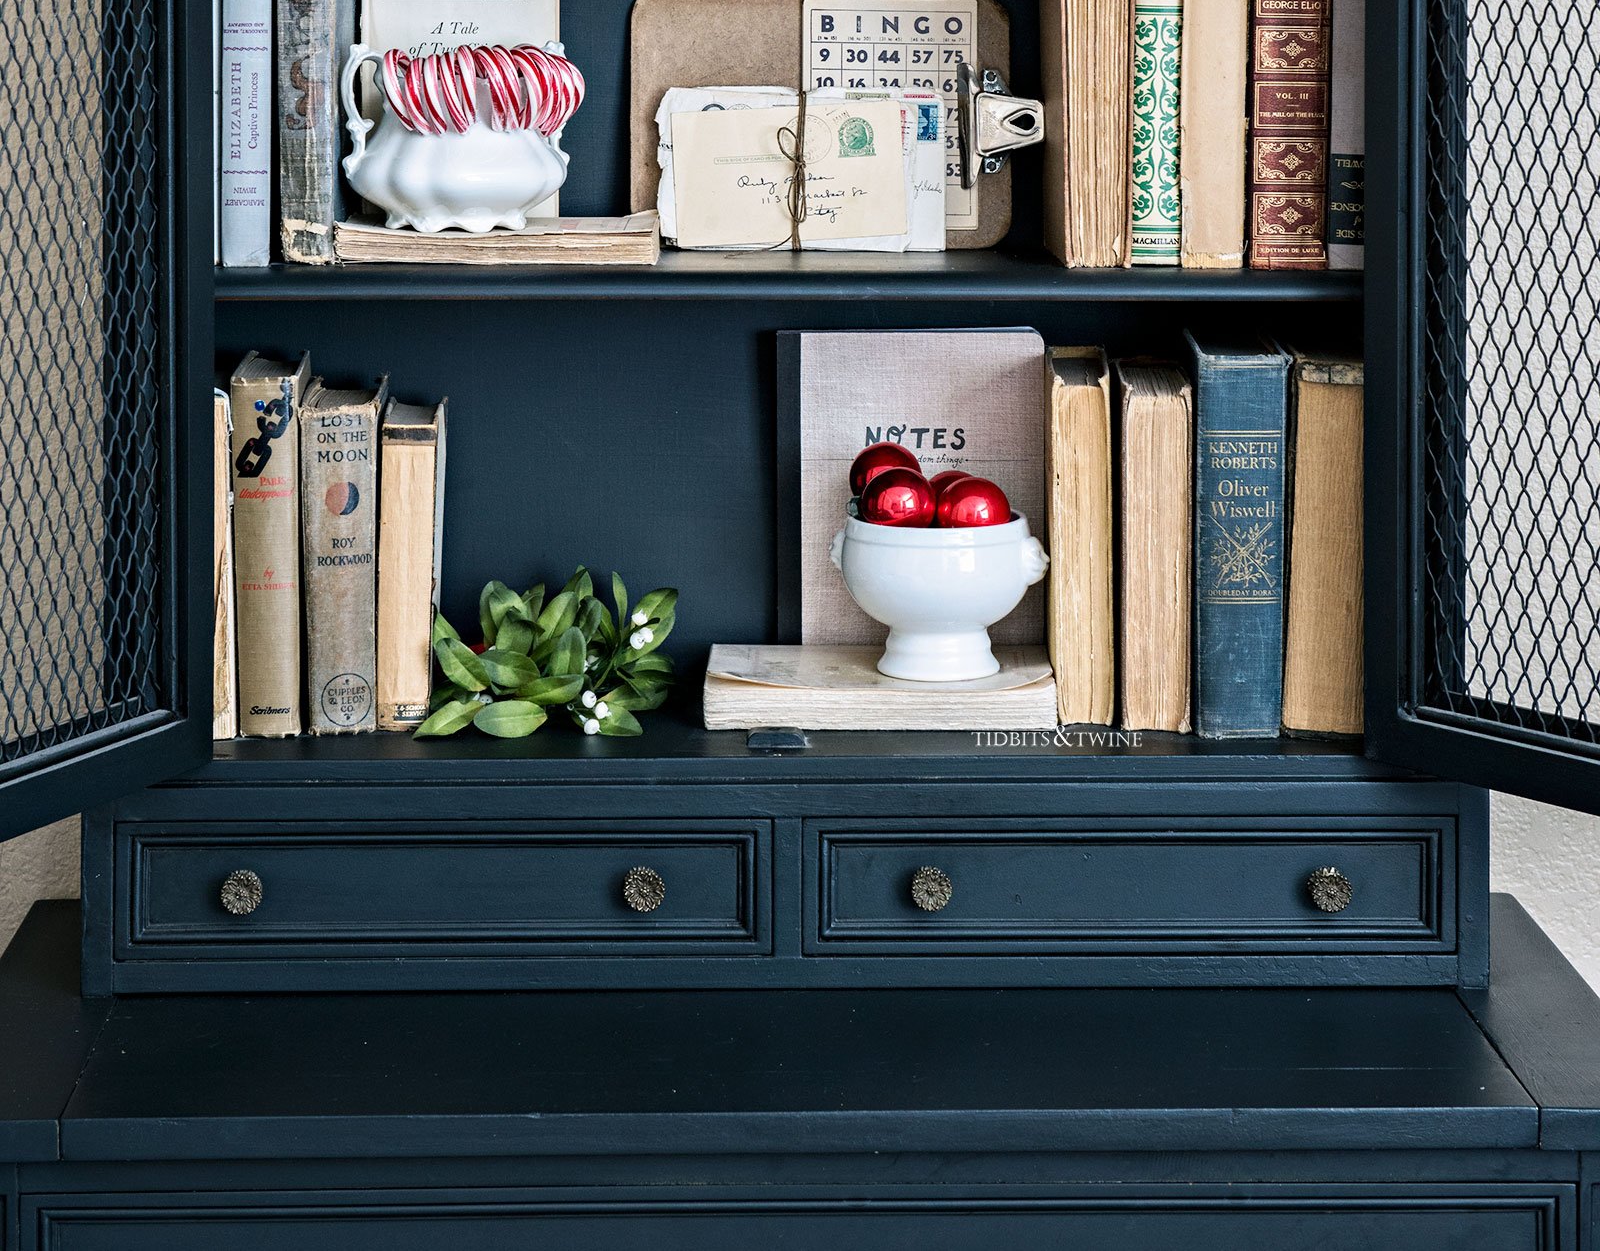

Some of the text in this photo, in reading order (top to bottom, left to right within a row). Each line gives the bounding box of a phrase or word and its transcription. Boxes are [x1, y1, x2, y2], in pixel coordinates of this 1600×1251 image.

[1262, 0, 1299, 10] GEORGE
[431, 21, 480, 35] A Tale
[409, 42, 427, 59] of
[819, 49, 964, 64] 9 30 44 57 75
[816, 76, 835, 88] 10
[848, 78, 866, 88] 16
[230, 62, 242, 160] ELIZABETH
[248, 72, 259, 150] Captive Princess
[1132, 237, 1180, 245] MACMILLAN
[321, 415, 362, 428] LOST
[317, 431, 368, 444] ON THE
[865, 424, 967, 451] NOTES
[1209, 442, 1278, 454] KENNETH
[318, 449, 369, 463] MOON
[1211, 456, 1277, 470] ROBERTS
[1218, 479, 1270, 497] Oliver
[1210, 500, 1277, 518] Wiswell
[332, 536, 357, 549] ROY
[317, 554, 373, 567] ROCKWOOD
[1208, 589, 1251, 597] DOUBLEDAY
[327, 685, 367, 697] CUPPLES
[341, 695, 366, 705] LEON
